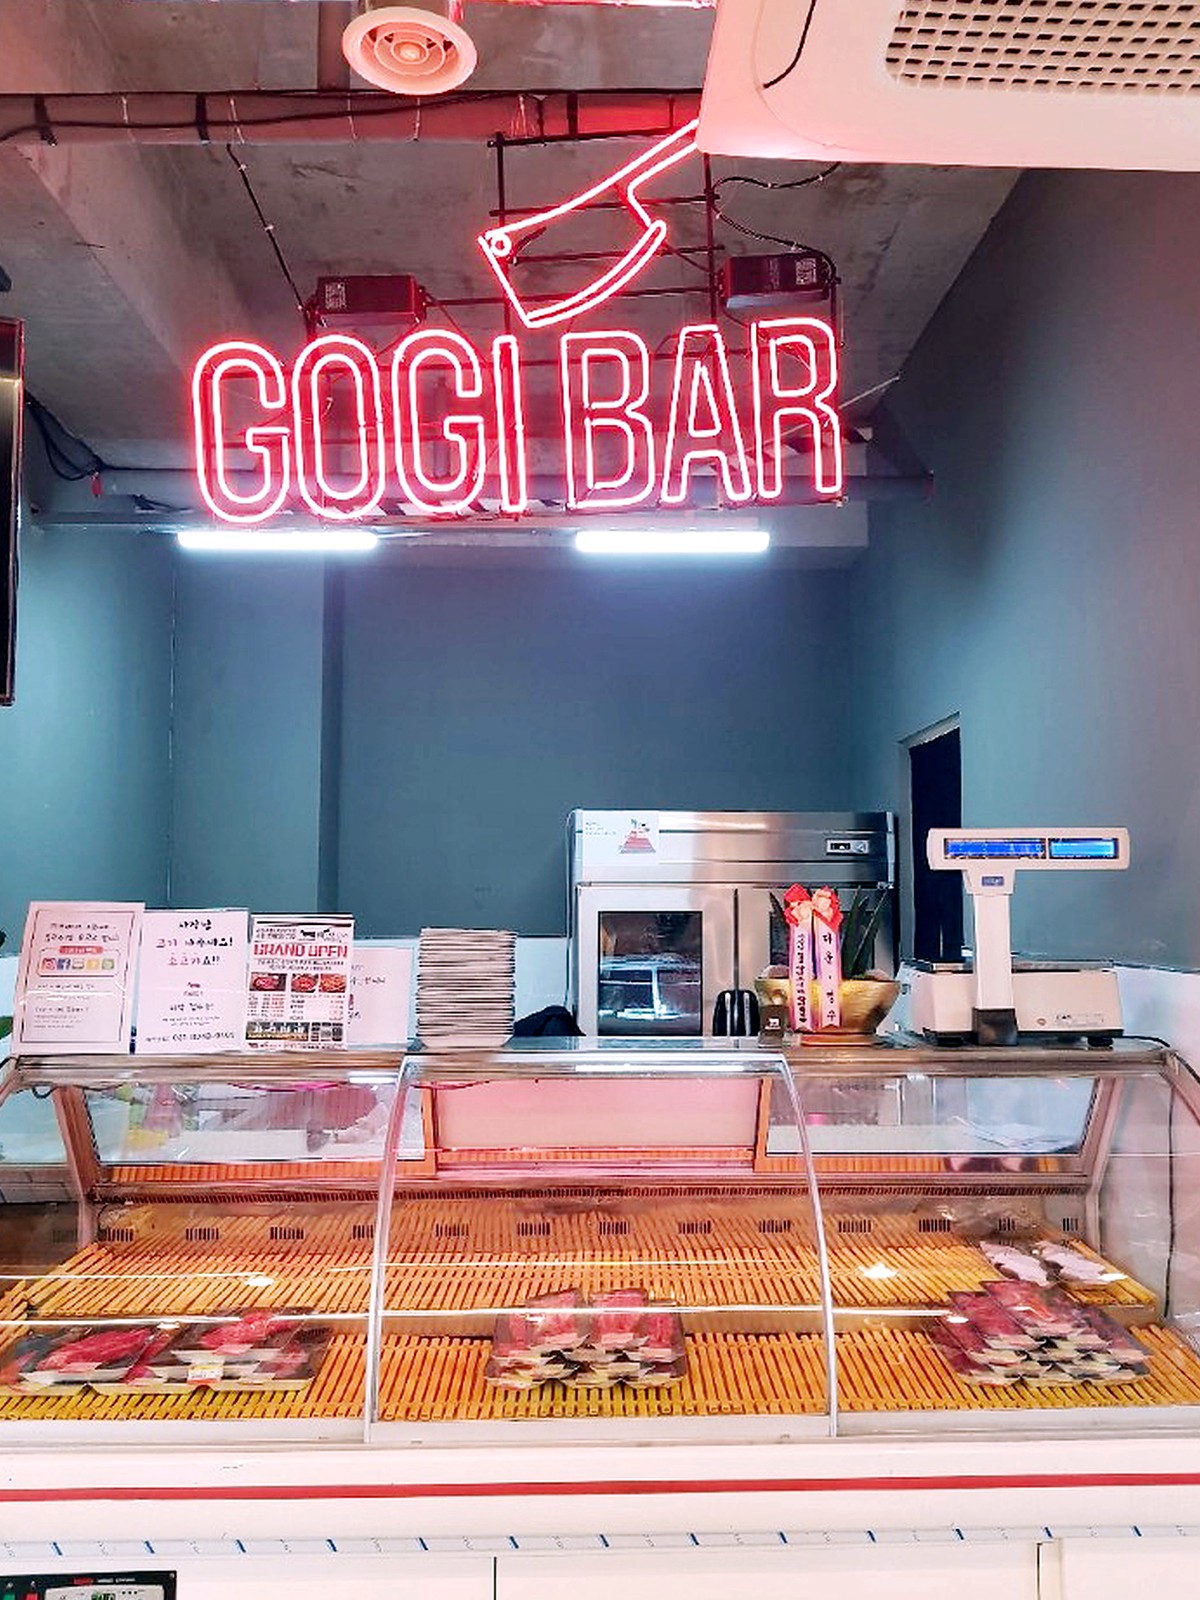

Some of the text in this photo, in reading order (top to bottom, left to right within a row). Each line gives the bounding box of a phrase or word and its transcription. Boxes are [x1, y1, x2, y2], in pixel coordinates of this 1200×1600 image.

[193, 317, 844, 523] GOGI BAR
[155, 937, 178, 949] 고기
[253, 944, 348, 958] GRAND OPEN
